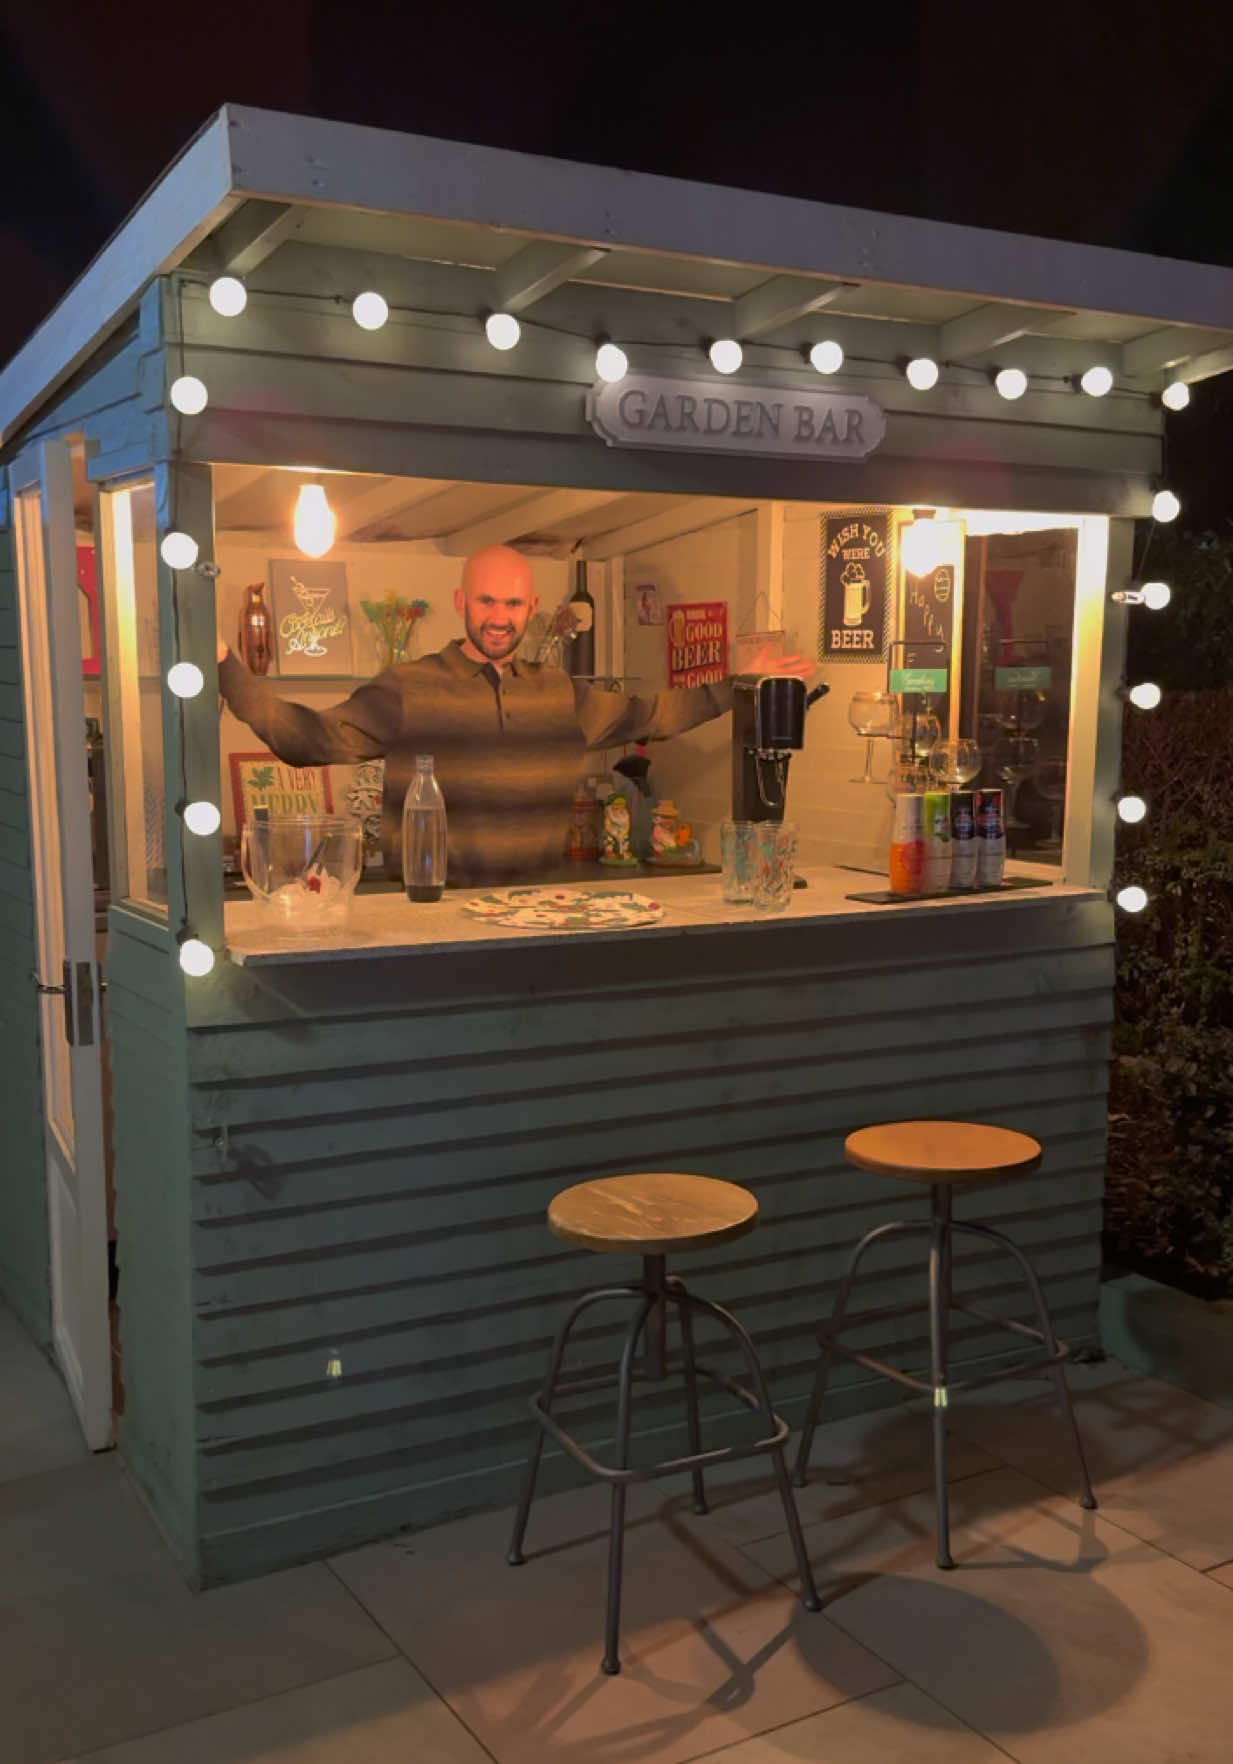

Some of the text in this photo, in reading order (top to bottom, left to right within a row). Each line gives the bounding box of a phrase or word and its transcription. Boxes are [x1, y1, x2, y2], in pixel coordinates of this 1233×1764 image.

[618, 389, 866, 444] GARDEN BAR
[827, 522, 886, 559] WISH YOU
[842, 547, 871, 560] WERE
[686, 622, 723, 642] GOOD
[830, 629, 875, 649] BEER
[671, 639, 722, 671] BEER
